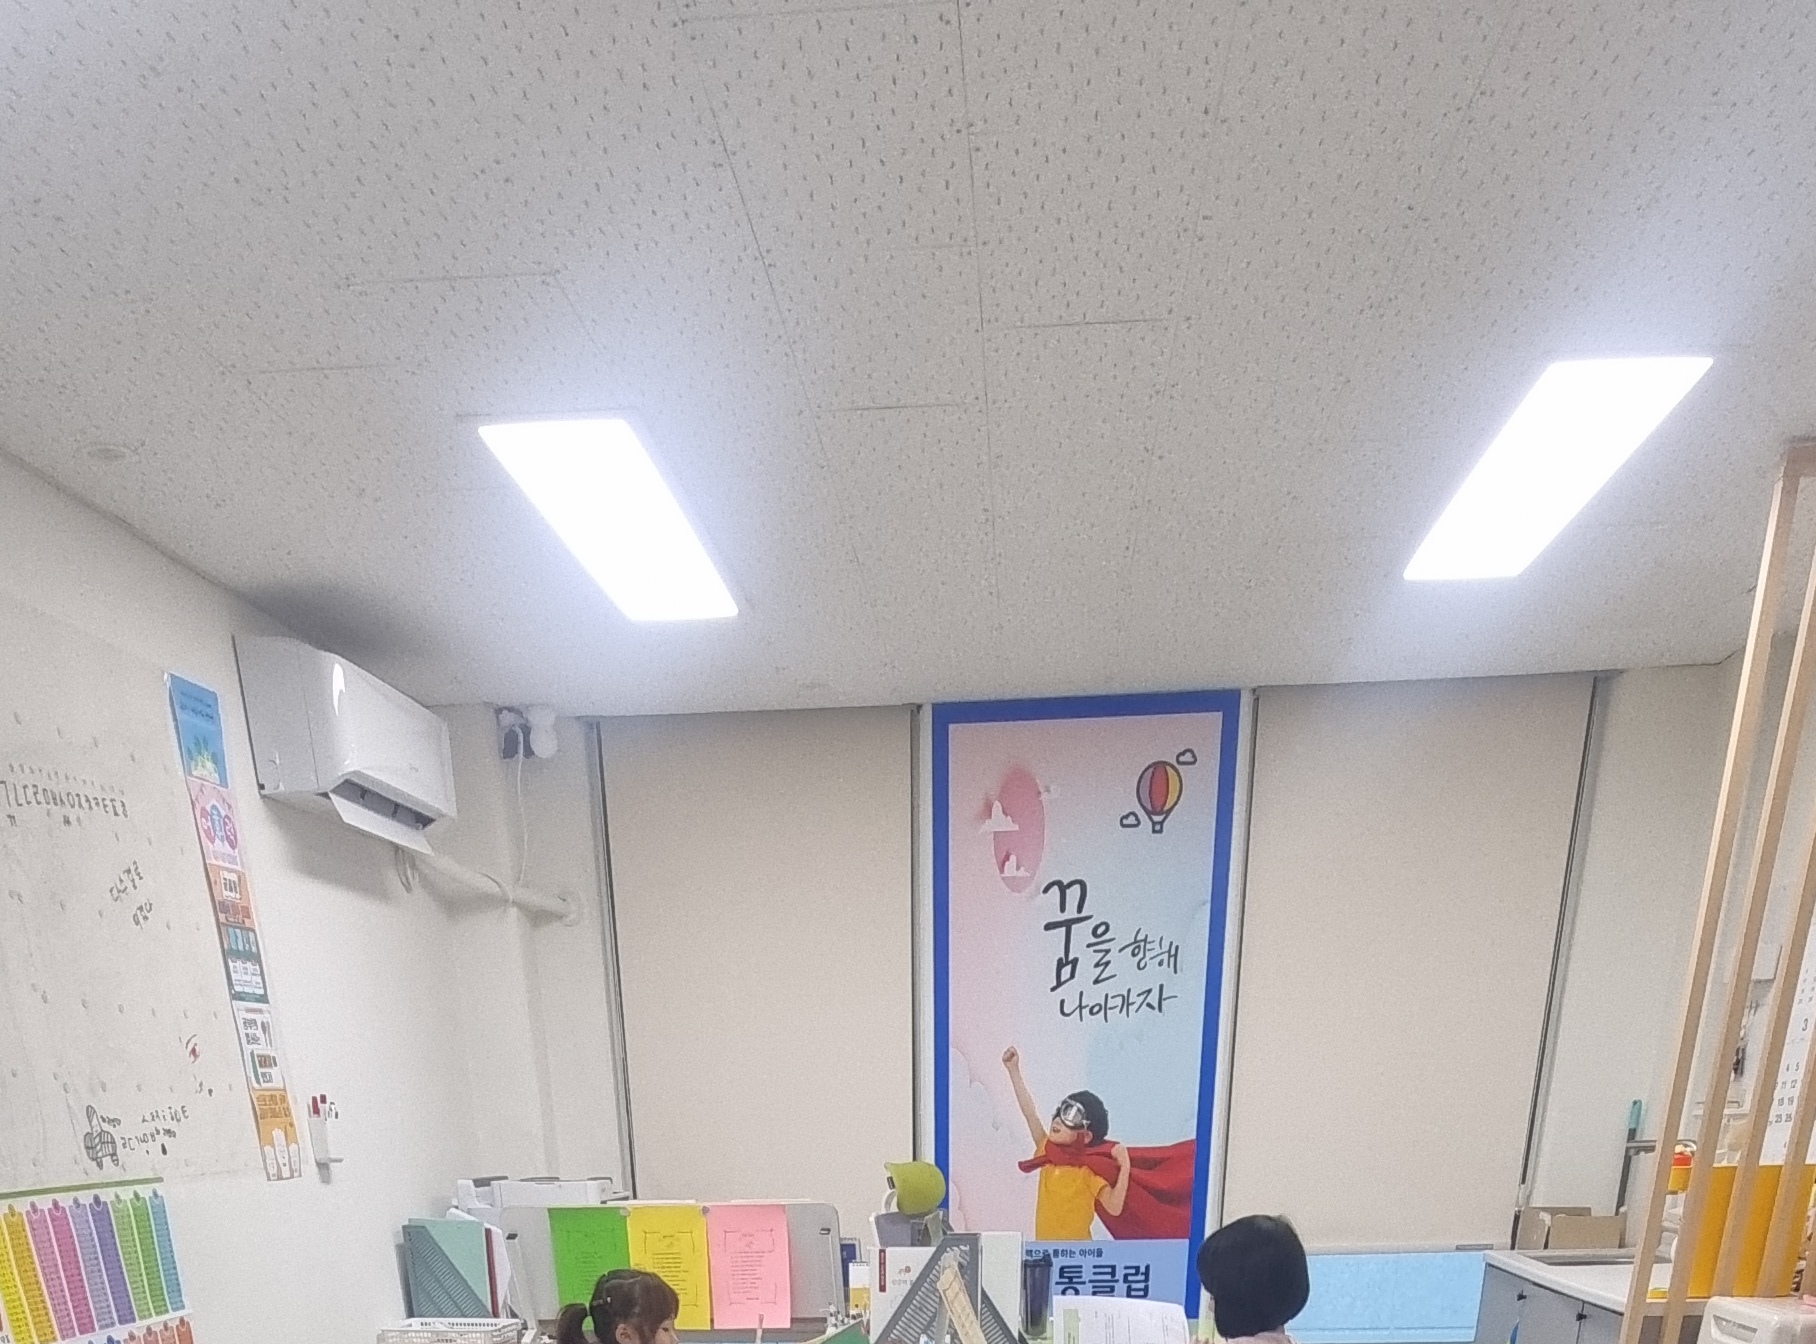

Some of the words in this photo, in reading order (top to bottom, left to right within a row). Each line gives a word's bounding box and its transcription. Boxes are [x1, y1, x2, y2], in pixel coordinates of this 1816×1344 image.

[1042, 879, 1118, 993] 꿈을
[1118, 927, 1179, 974] 향해
[1060, 983, 1178, 1023] 나아가자
[1078, 1247, 1104, 1259] 아이들
